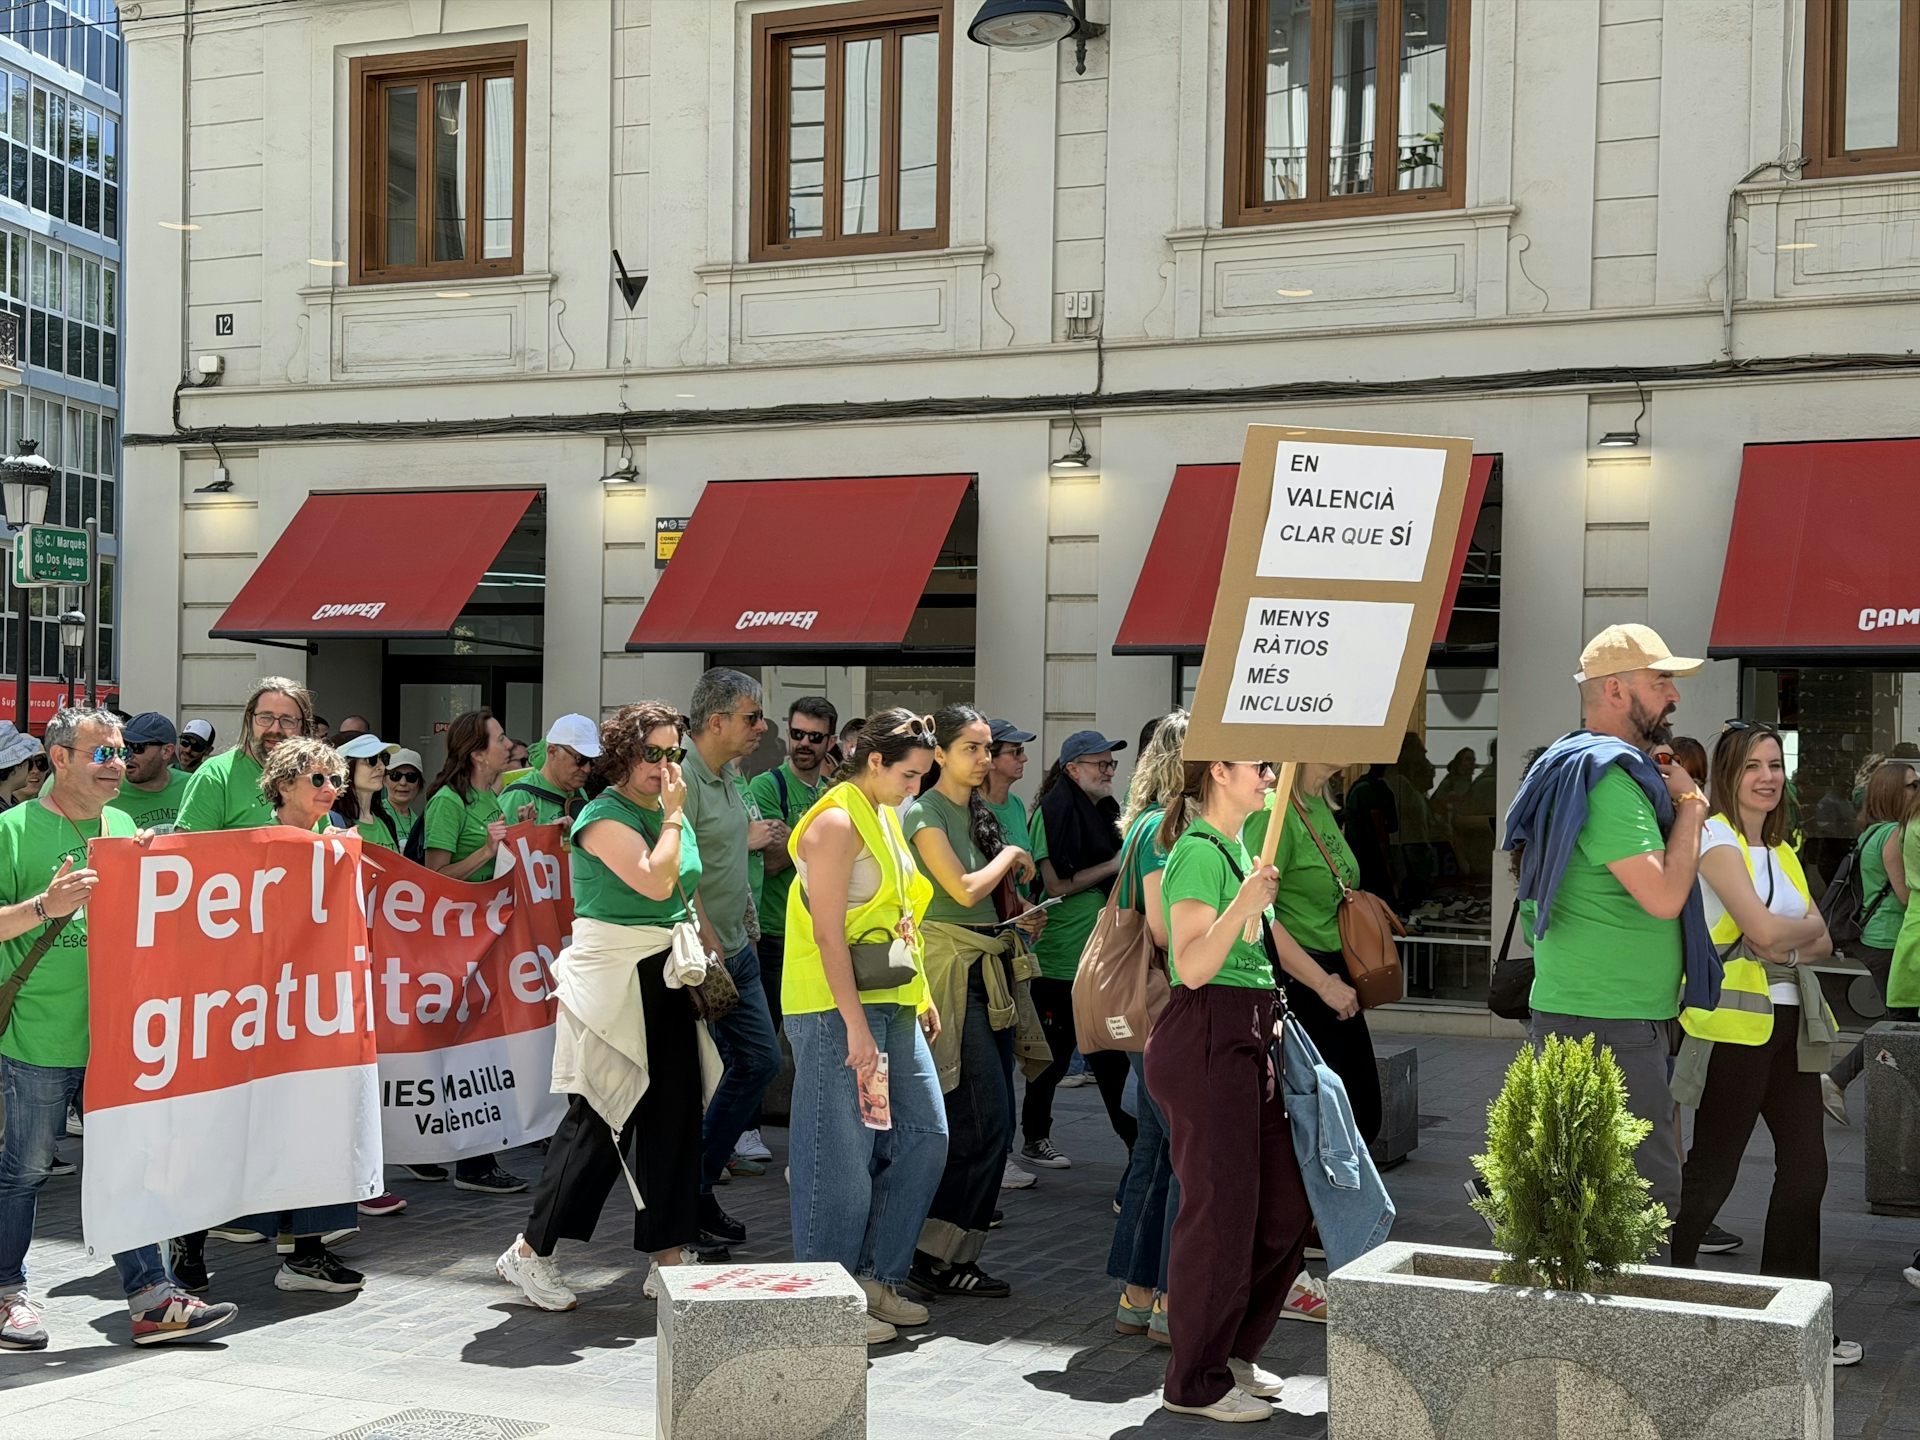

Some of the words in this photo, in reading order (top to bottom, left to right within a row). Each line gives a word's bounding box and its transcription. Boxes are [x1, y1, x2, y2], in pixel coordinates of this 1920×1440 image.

[219, 316, 231, 334] 12
[1290, 454, 1319, 473] EN
[1287, 487, 1395, 511] VALENCIÀ
[1280, 525, 1336, 544] CLAR
[1341, 527, 1384, 546] QUE
[1389, 521, 1414, 547] SÍ
[35, 552, 44, 563] de
[46, 553, 60, 565] Dos
[63, 554, 84, 569] Aguas
[312, 602, 386, 620] CAMPER
[735, 610, 819, 630] CAMPER
[1260, 609, 1330, 628] MENYS
[1858, 608, 1920, 631] CAM
[1253, 634, 1328, 656] RÀTIOS
[1247, 664, 1290, 684] MÉS
[1239, 693, 1333, 713] INCLUSIÓ
[136, 854, 287, 947] Per
[383, 1079, 435, 1107] IES
[441, 1065, 516, 1104] Malilla
[415, 1101, 502, 1135] València
